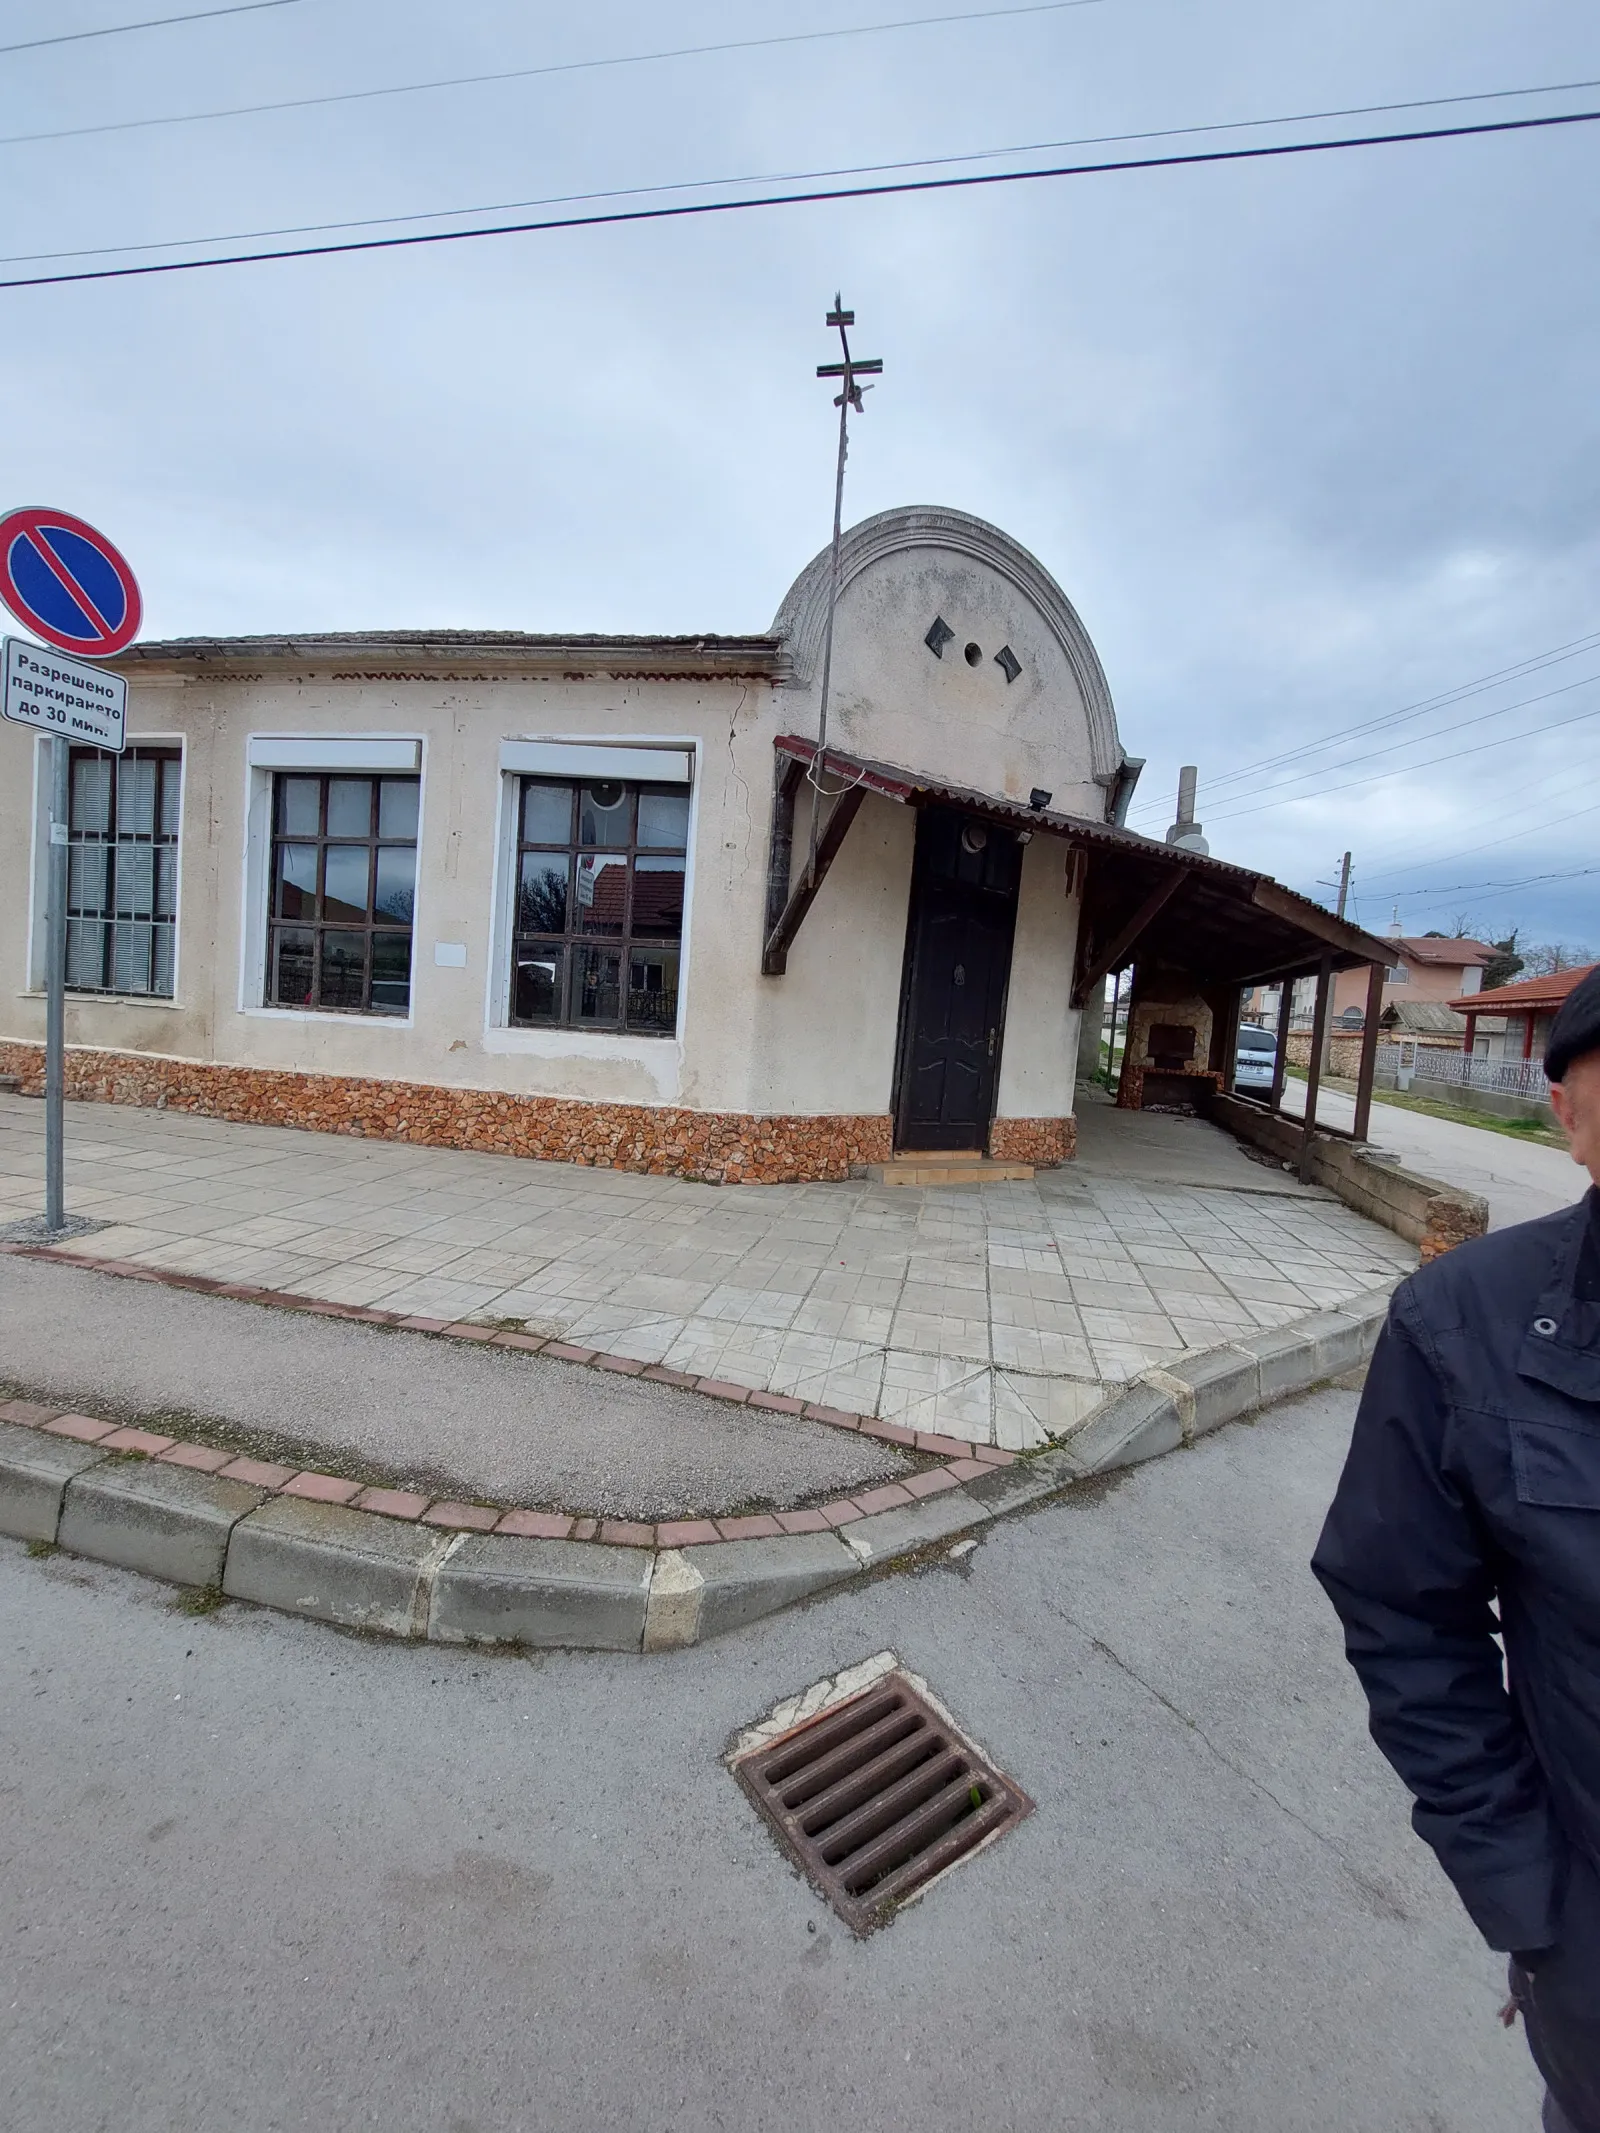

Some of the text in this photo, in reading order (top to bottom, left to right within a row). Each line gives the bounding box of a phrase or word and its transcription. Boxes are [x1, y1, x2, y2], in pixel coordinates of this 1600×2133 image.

[12, 675, 121, 720] паркирането
[18, 654, 115, 698] Разрешено
[18, 701, 40, 716] до
[46, 705, 67, 724] 30
